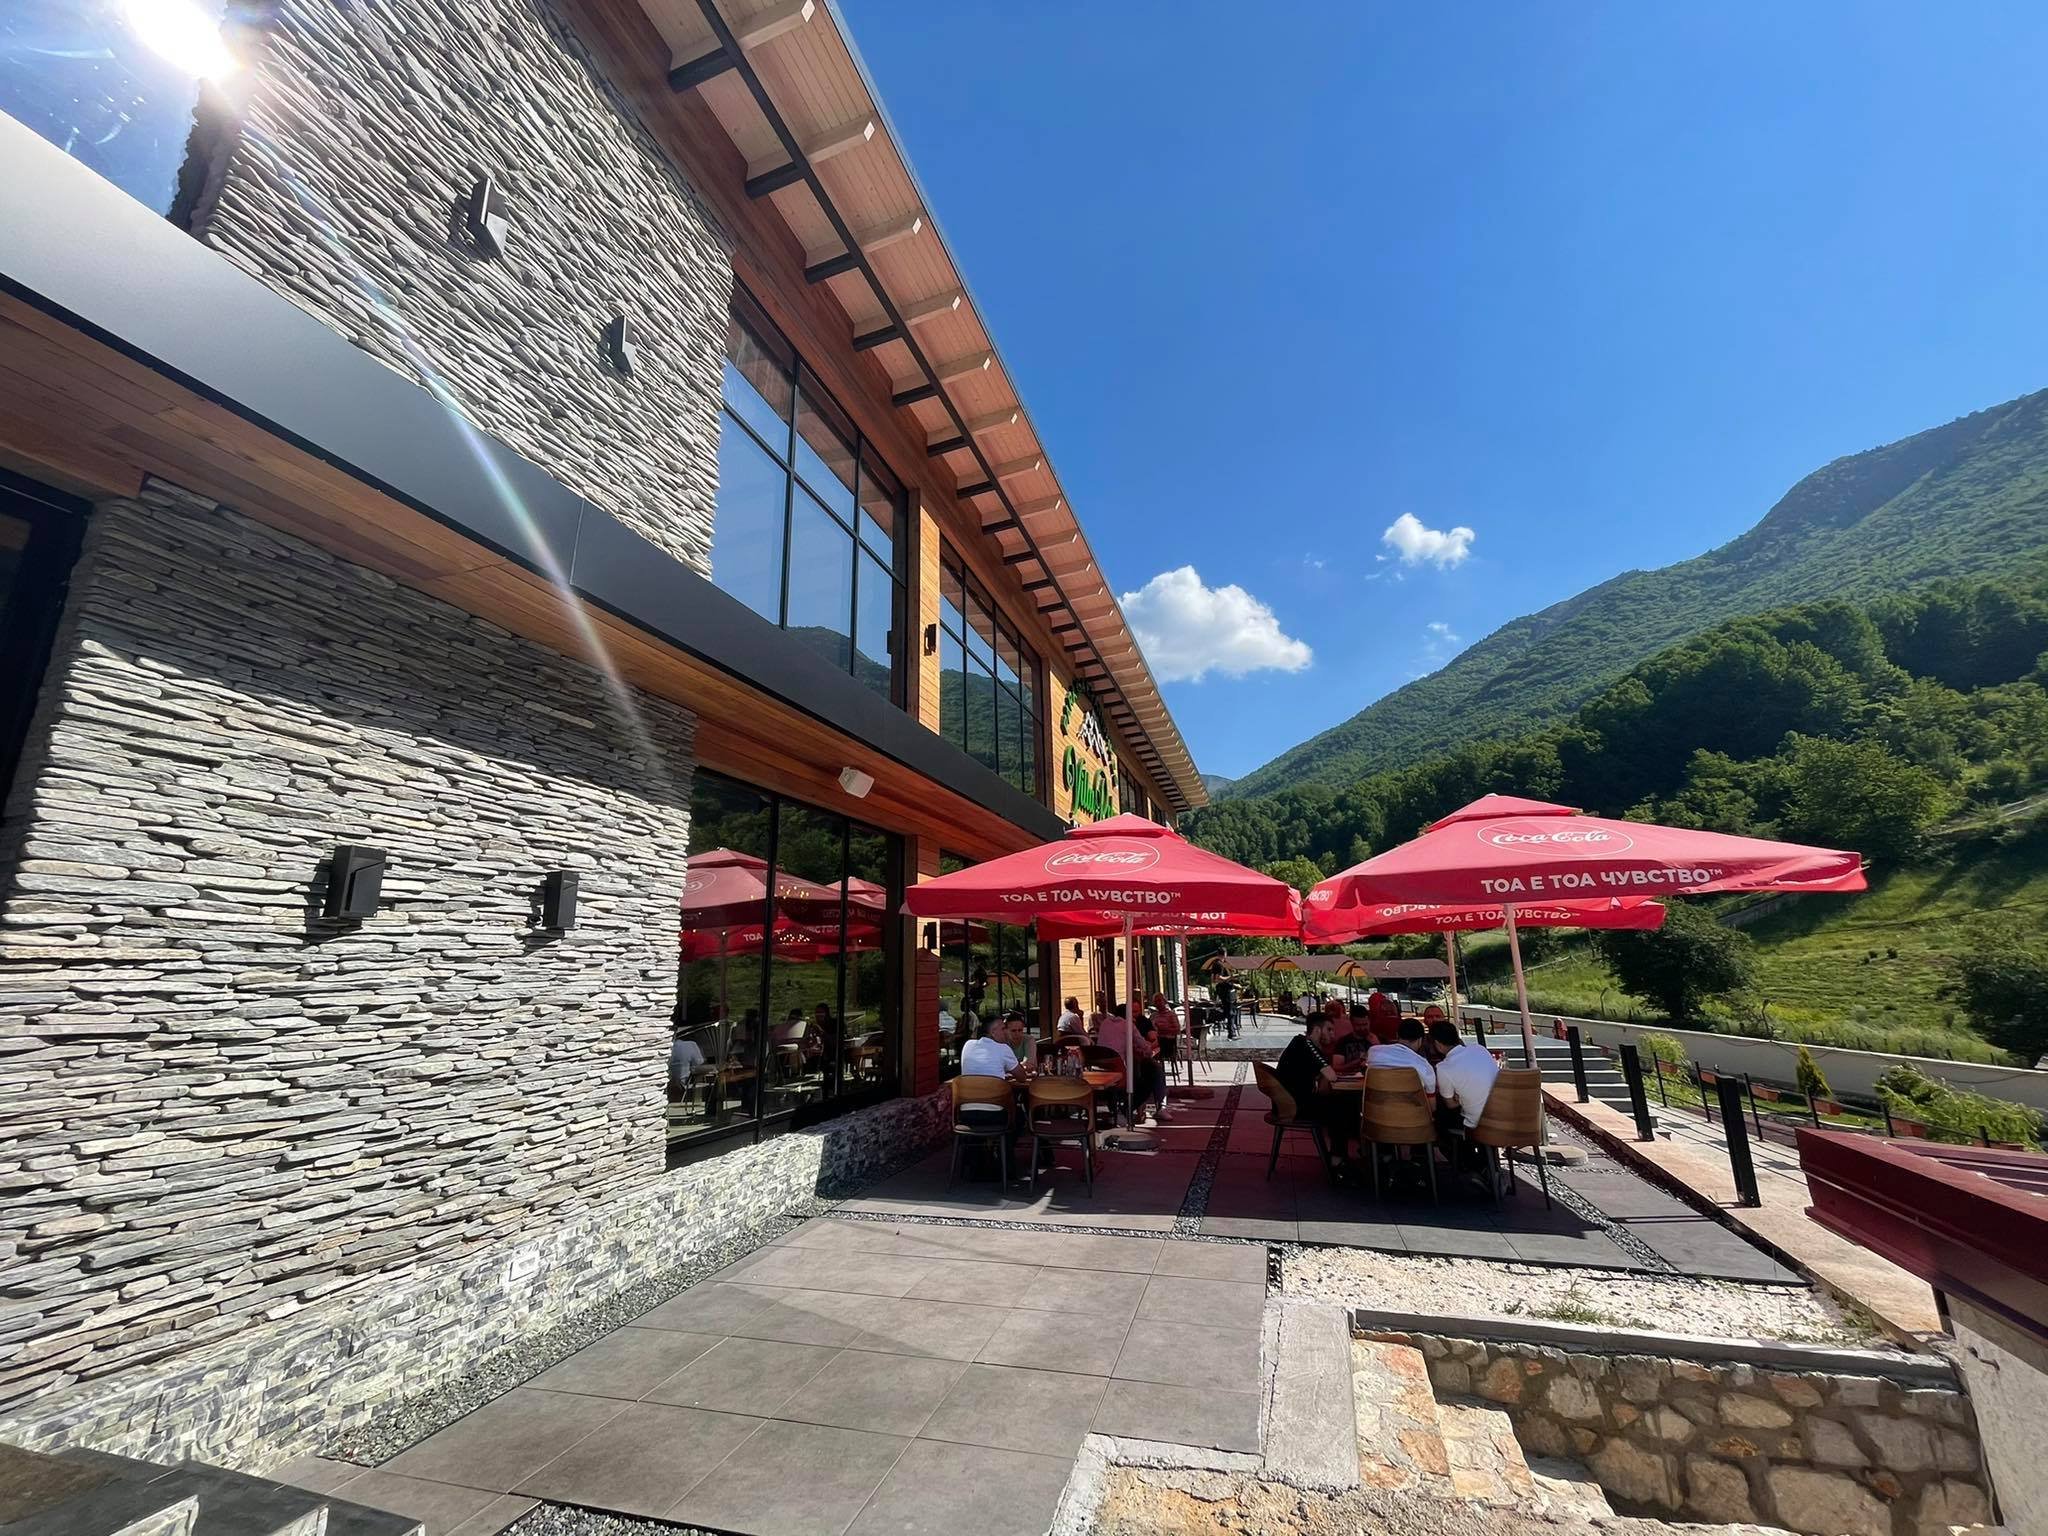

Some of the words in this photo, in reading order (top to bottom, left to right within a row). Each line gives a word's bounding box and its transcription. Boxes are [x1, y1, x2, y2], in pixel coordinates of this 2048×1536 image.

[1480, 877, 1527, 894] ТОА
[1529, 875, 1545, 890] Е
[1548, 872, 1597, 889] ТОА
[999, 892, 1036, 903] ТОА
[1037, 891, 1049, 902] Е
[1050, 889, 1085, 902] ТОА
[1435, 915, 1462, 925] ТОА
[1464, 913, 1475, 922] Е
